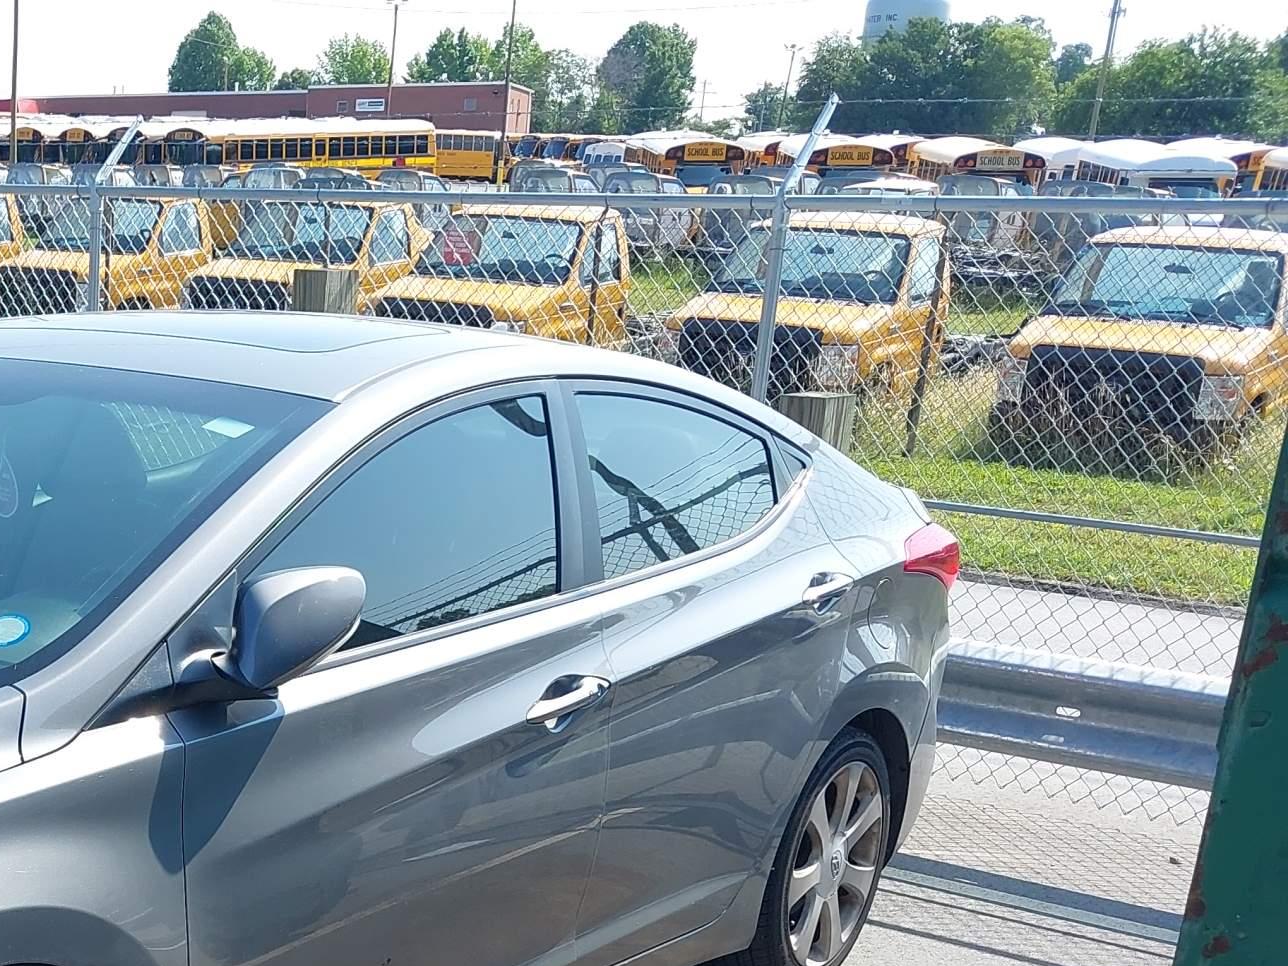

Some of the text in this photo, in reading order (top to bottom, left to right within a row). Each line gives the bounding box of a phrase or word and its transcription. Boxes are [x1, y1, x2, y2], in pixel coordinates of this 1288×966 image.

[885, 13, 898, 21] INC
[687, 147, 724, 156] SCHOOL BUS
[830, 151, 871, 161] SCHOOL BUS
[979, 156, 1021, 166] SCHOOL BUS
